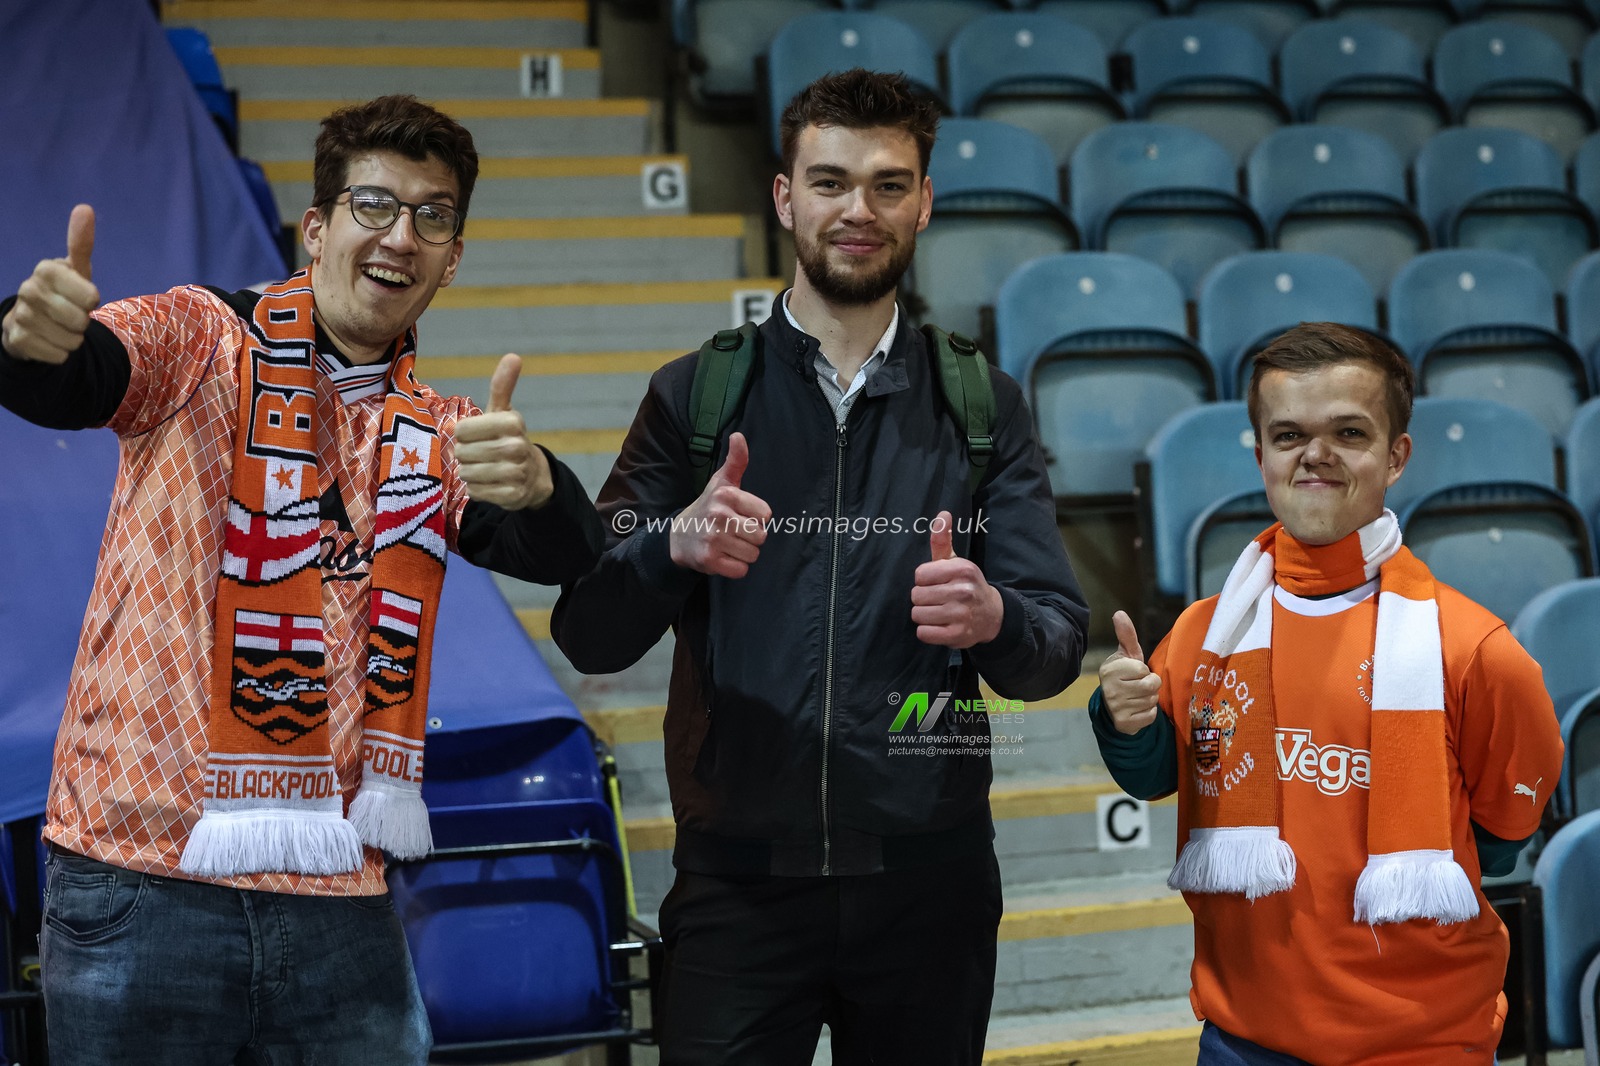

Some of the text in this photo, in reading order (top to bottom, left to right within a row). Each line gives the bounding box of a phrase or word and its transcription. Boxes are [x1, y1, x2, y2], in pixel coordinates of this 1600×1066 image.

[529, 58, 550, 93] H
[649, 168, 679, 201] G
[1223, 751, 1255, 791] CLUB
[1106, 798, 1141, 843] C
